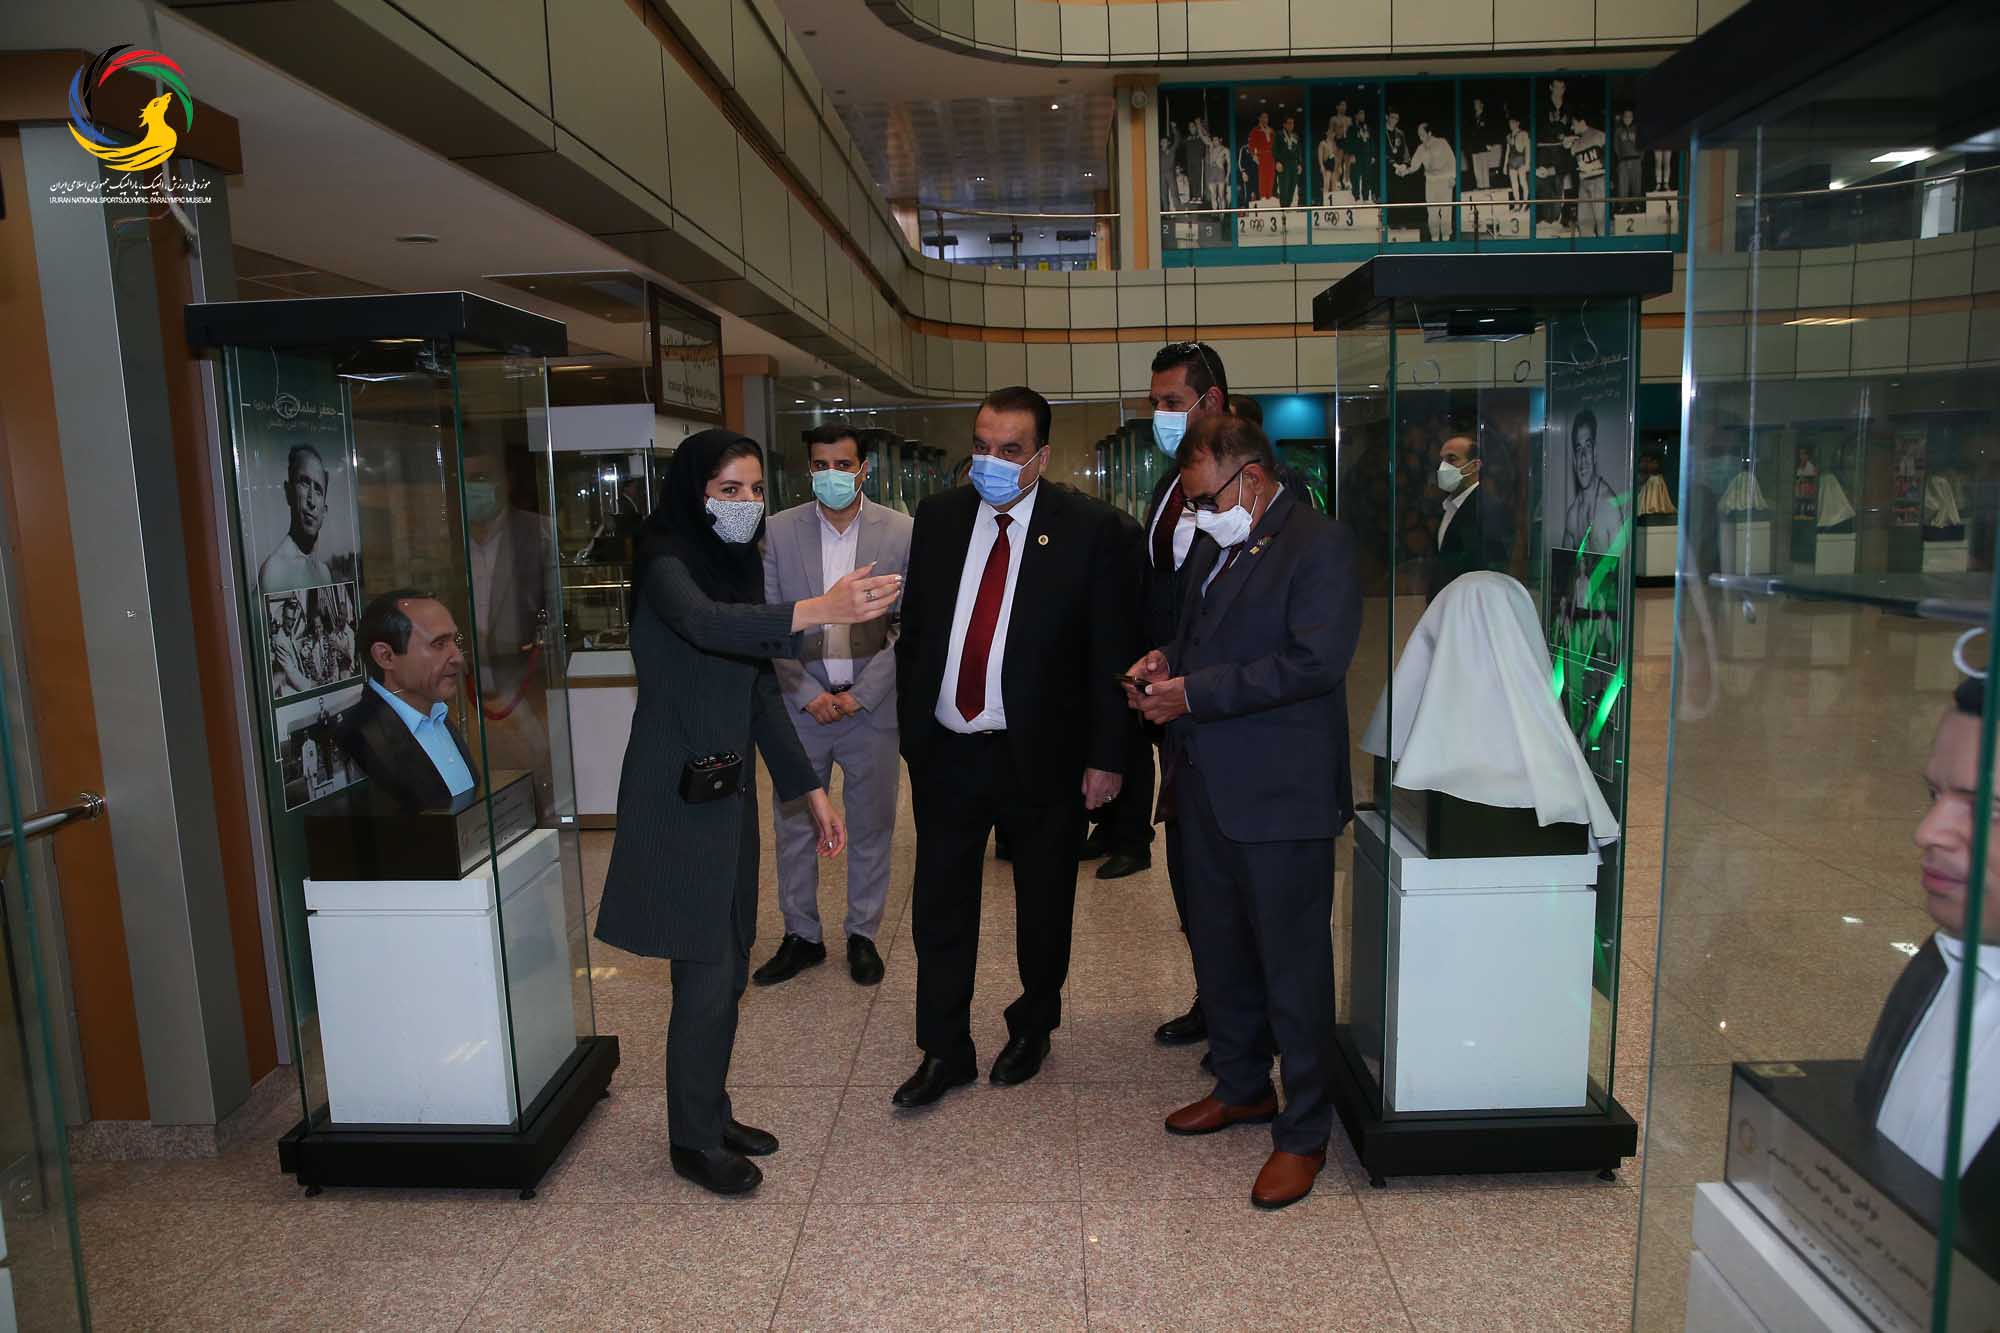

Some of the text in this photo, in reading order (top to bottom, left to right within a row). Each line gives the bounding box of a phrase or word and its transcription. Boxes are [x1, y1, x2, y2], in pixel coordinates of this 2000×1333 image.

[1269, 216, 1278, 233] 3
[1313, 211, 1320, 227] 2
[1346, 209, 1354, 227] 3
[1510, 217, 1520, 234] 3
[1625, 217, 1635, 233] 2
[1239, 219, 1247, 234] 2
